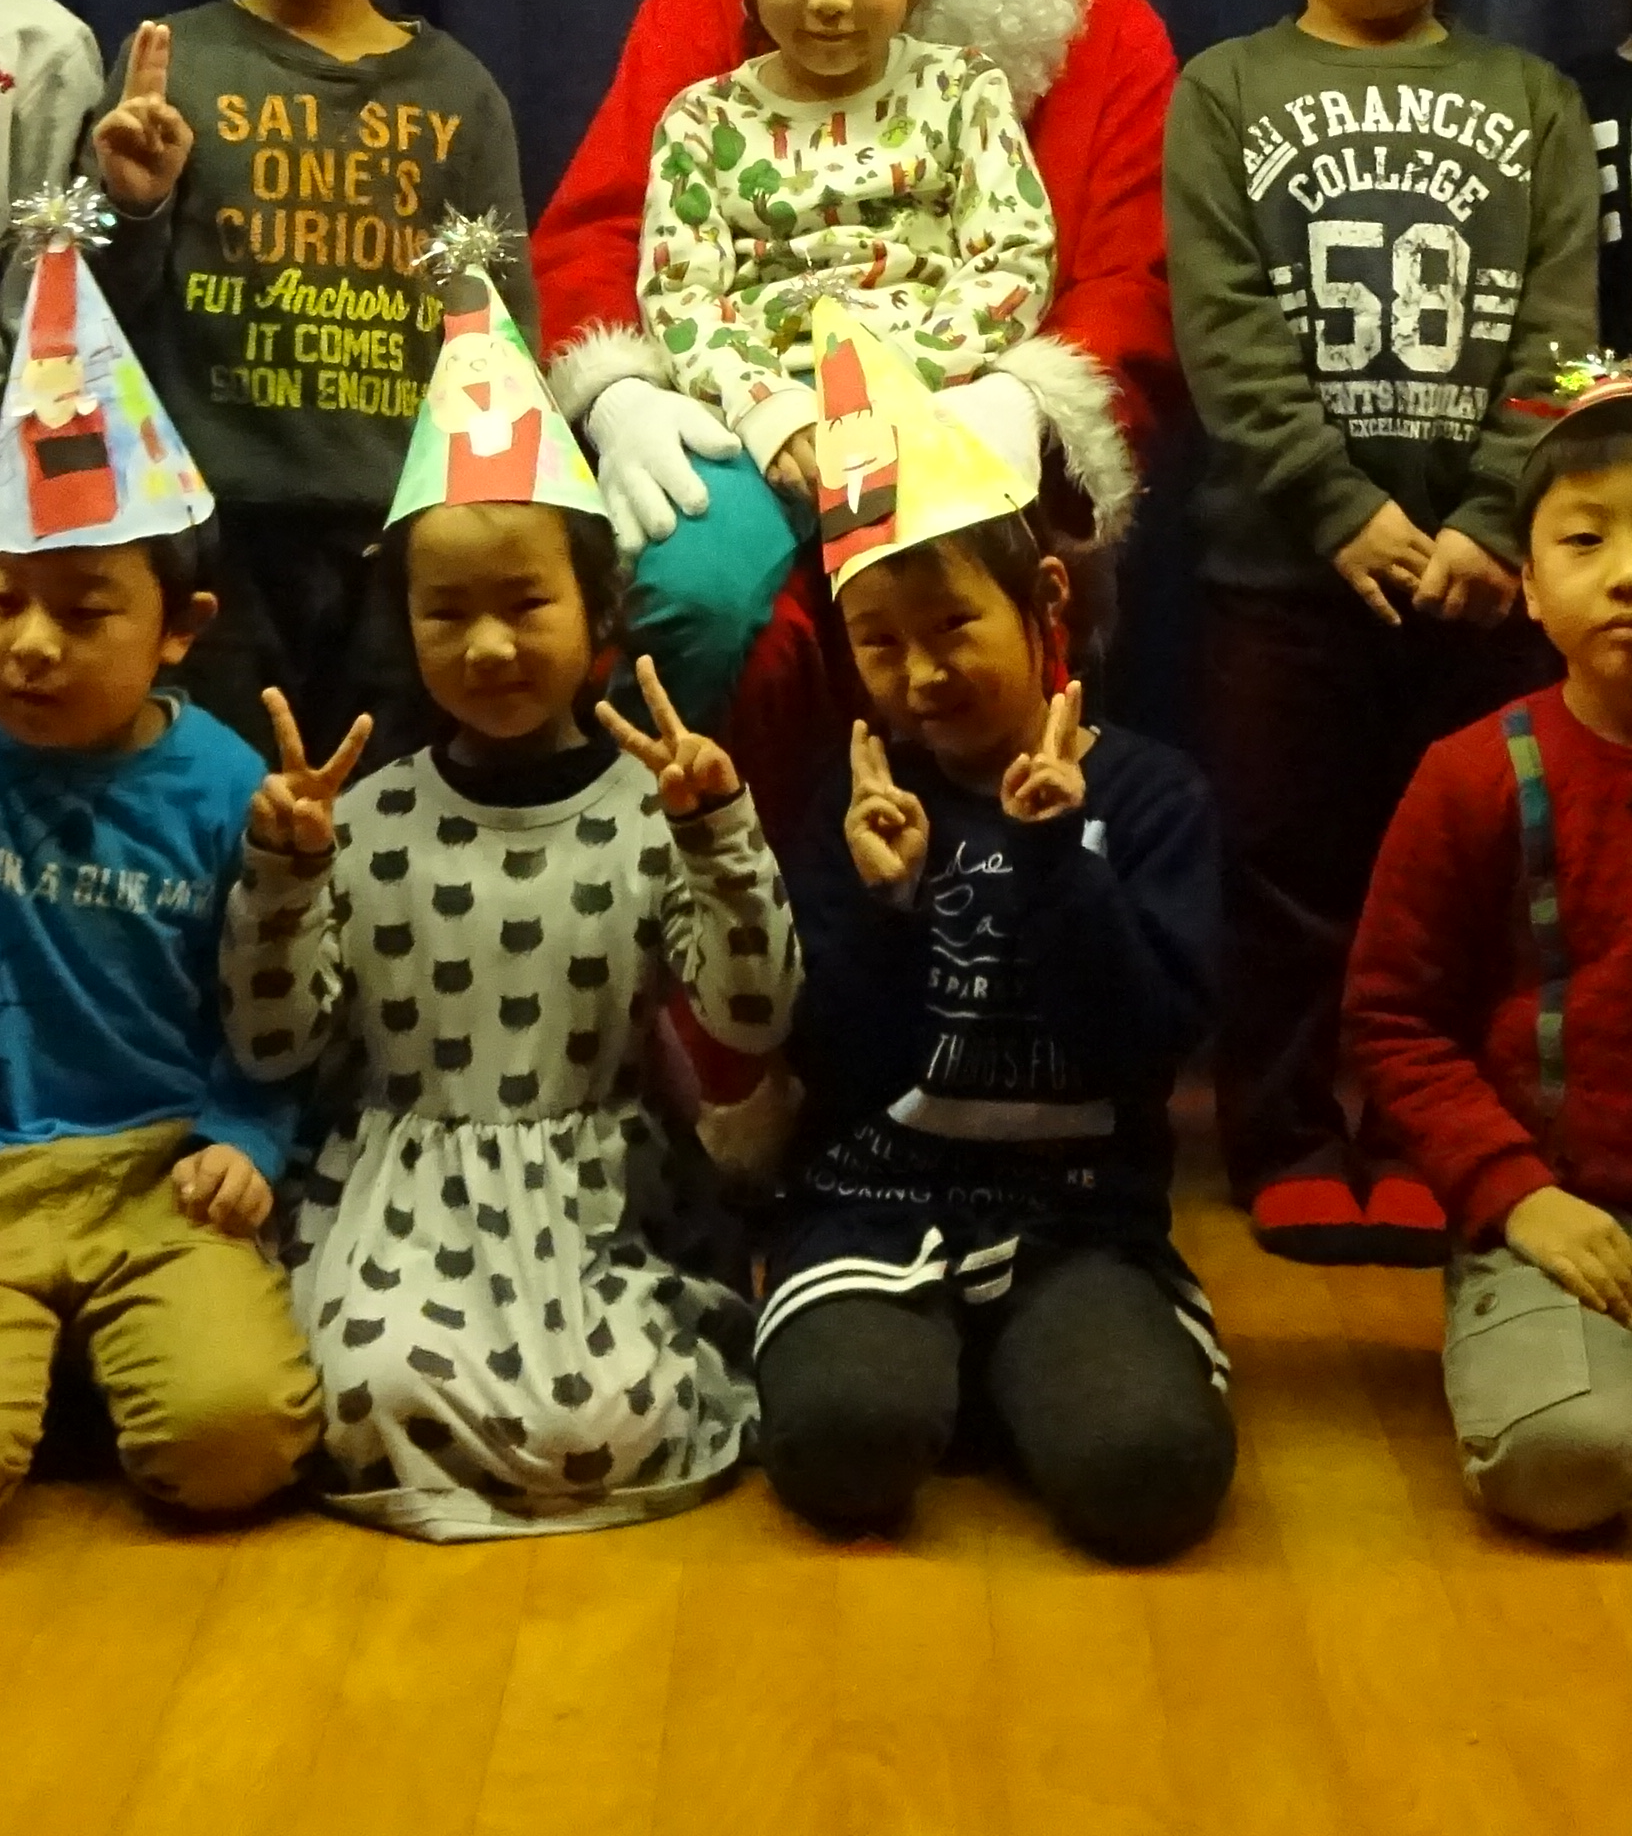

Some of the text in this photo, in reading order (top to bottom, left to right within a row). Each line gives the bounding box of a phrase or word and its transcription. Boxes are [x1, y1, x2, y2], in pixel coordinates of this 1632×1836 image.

[252, 147, 422, 217] ONE'S
[1288, 146, 1491, 223] COLLEGE
[255, 267, 411, 322] Anchors
[1307, 220, 1470, 373] 58
[245, 321, 404, 372] IT COMES
